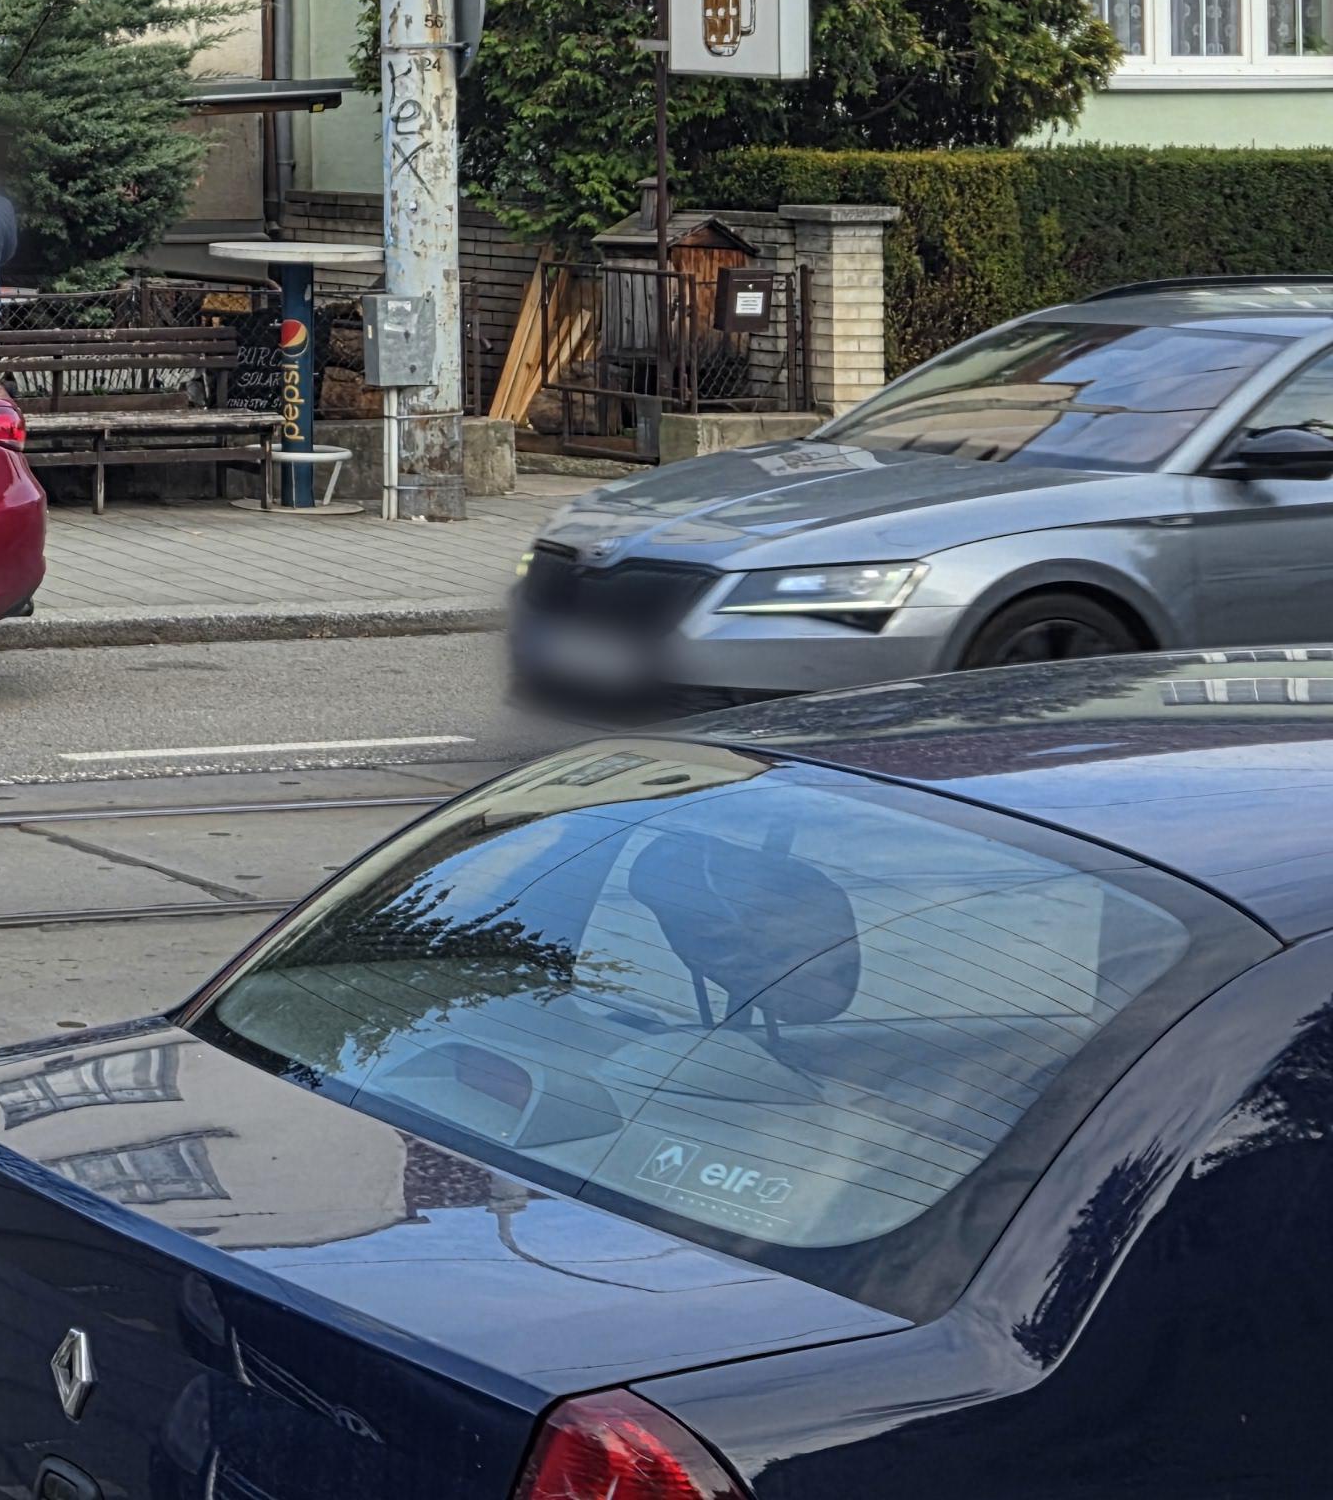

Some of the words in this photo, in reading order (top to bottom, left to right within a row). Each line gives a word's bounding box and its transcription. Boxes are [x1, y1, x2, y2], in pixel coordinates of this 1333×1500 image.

[424, 14, 444, 28] 56
[423, 57, 441, 72] 24
[283, 363, 305, 441] pepsi
[699, 1162, 761, 1194] elf
